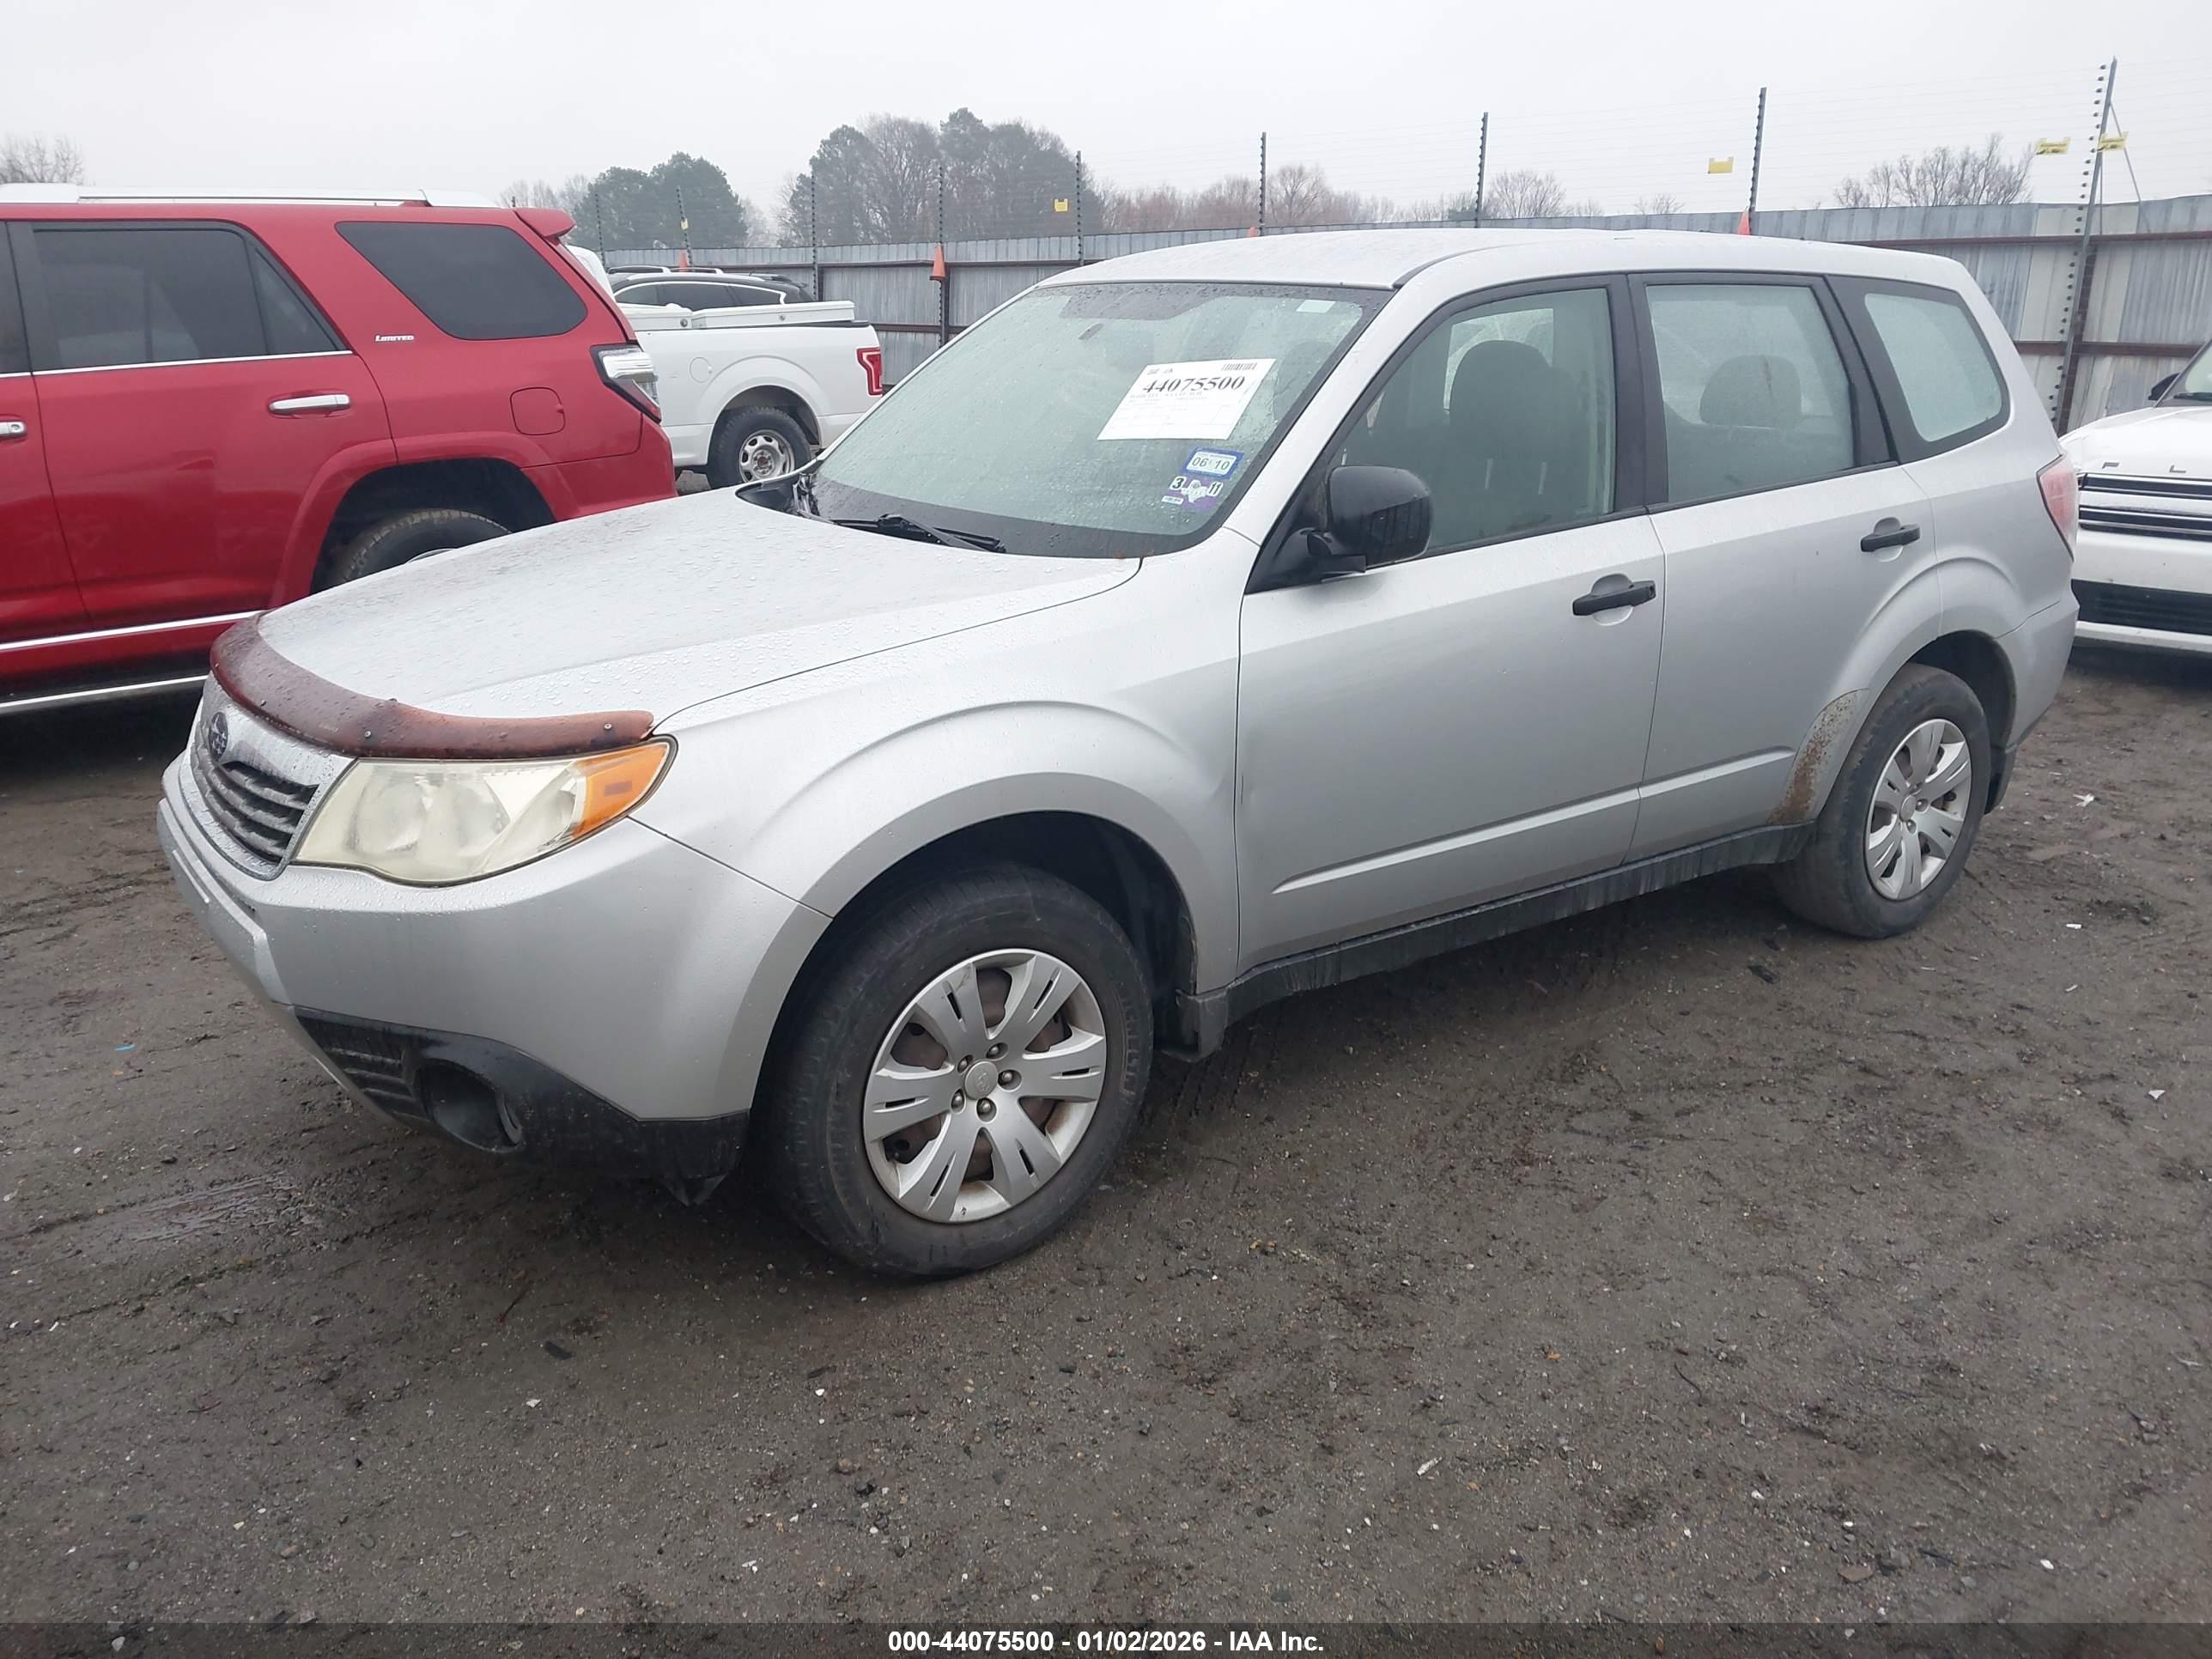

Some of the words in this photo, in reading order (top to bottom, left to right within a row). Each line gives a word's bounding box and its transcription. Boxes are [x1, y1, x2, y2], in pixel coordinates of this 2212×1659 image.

[1142, 375, 1246, 393] 44075500
[1192, 457, 1209, 467] 06
[1214, 459, 1231, 471] 10
[1172, 477, 1184, 489] 3
[1208, 482, 1222, 495] 11
